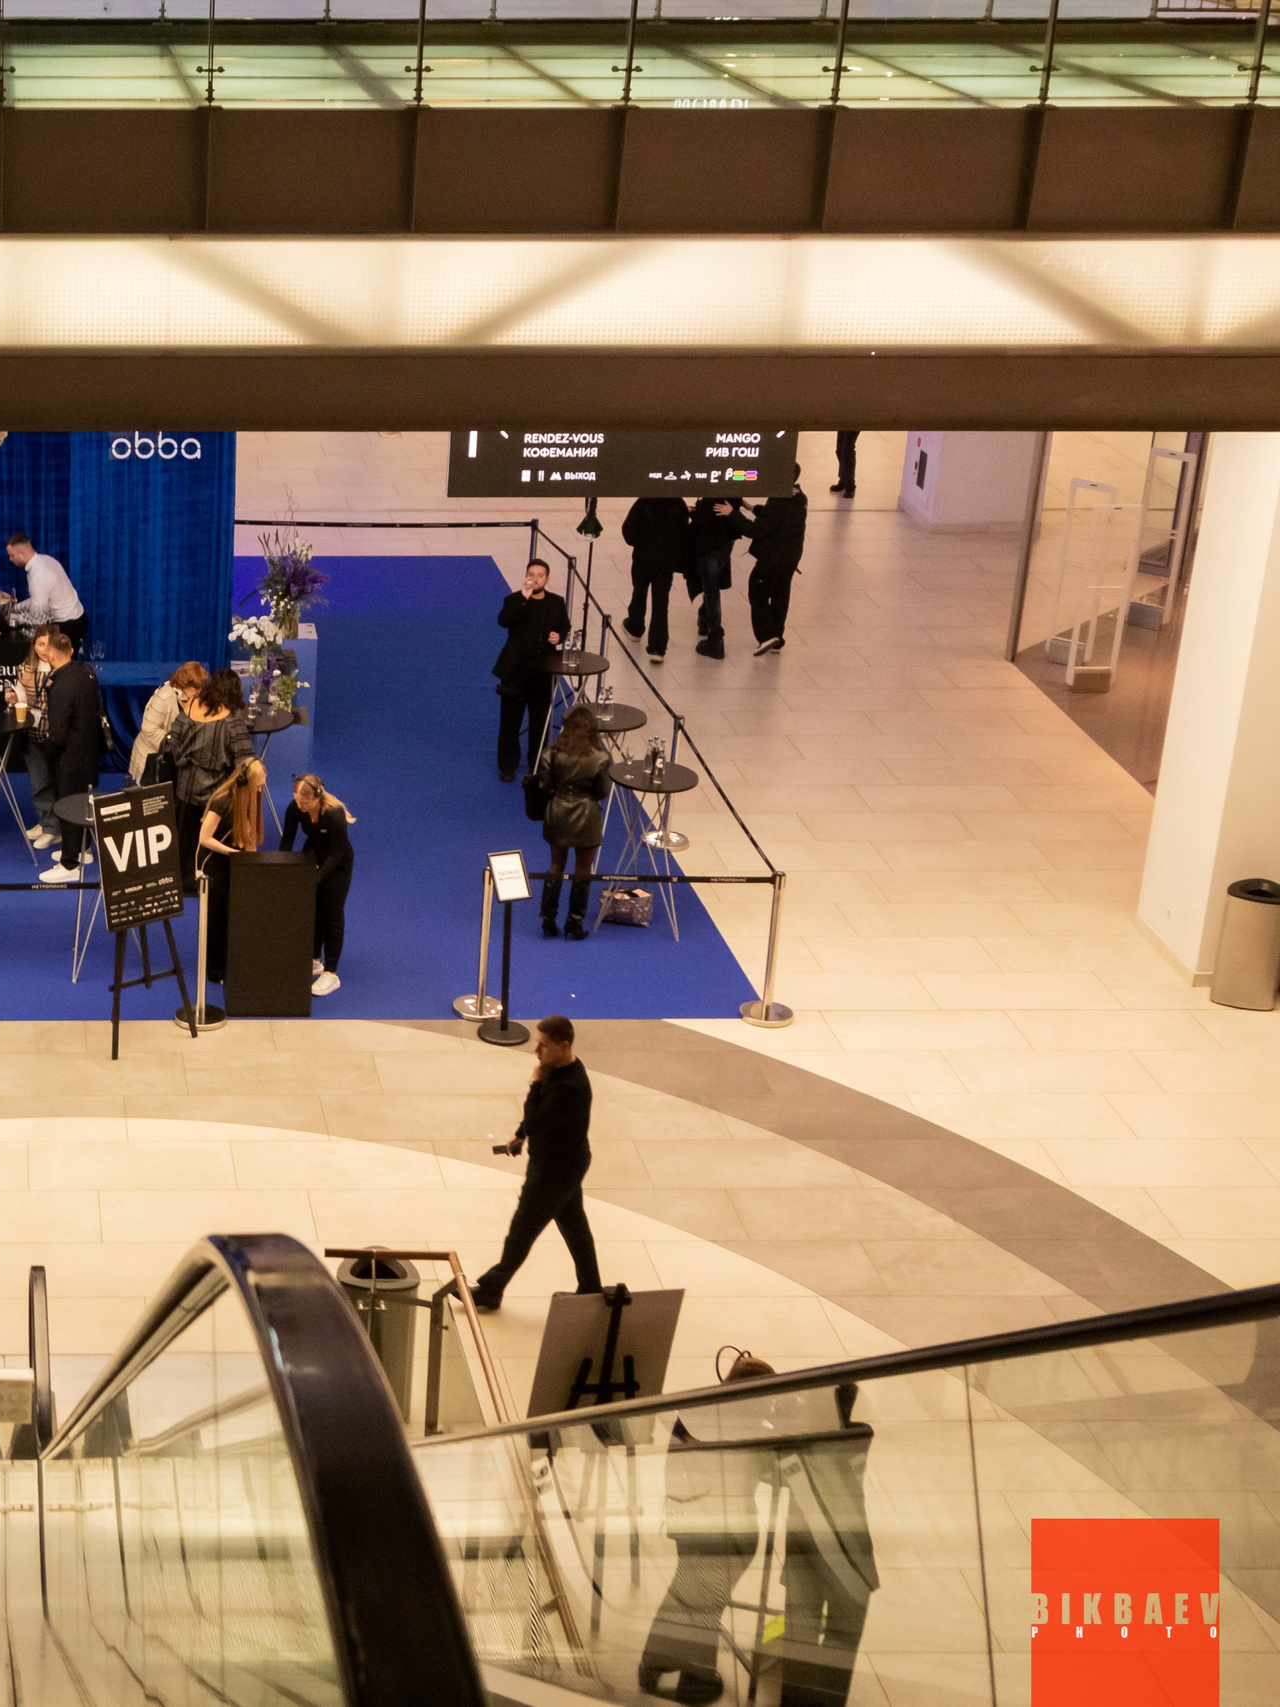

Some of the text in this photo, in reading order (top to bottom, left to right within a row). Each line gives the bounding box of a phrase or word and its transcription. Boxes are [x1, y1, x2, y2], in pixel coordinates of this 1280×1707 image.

[523, 433, 605, 444] RENDEZ-VOUS
[715, 433, 761, 444] MANGO
[522, 447, 598, 458] КОФЕМАНИЯ
[705, 447, 760, 458] РИВ ГОШ
[564, 471, 597, 481] ВЫХОД
[103, 824, 172, 873] VIP
